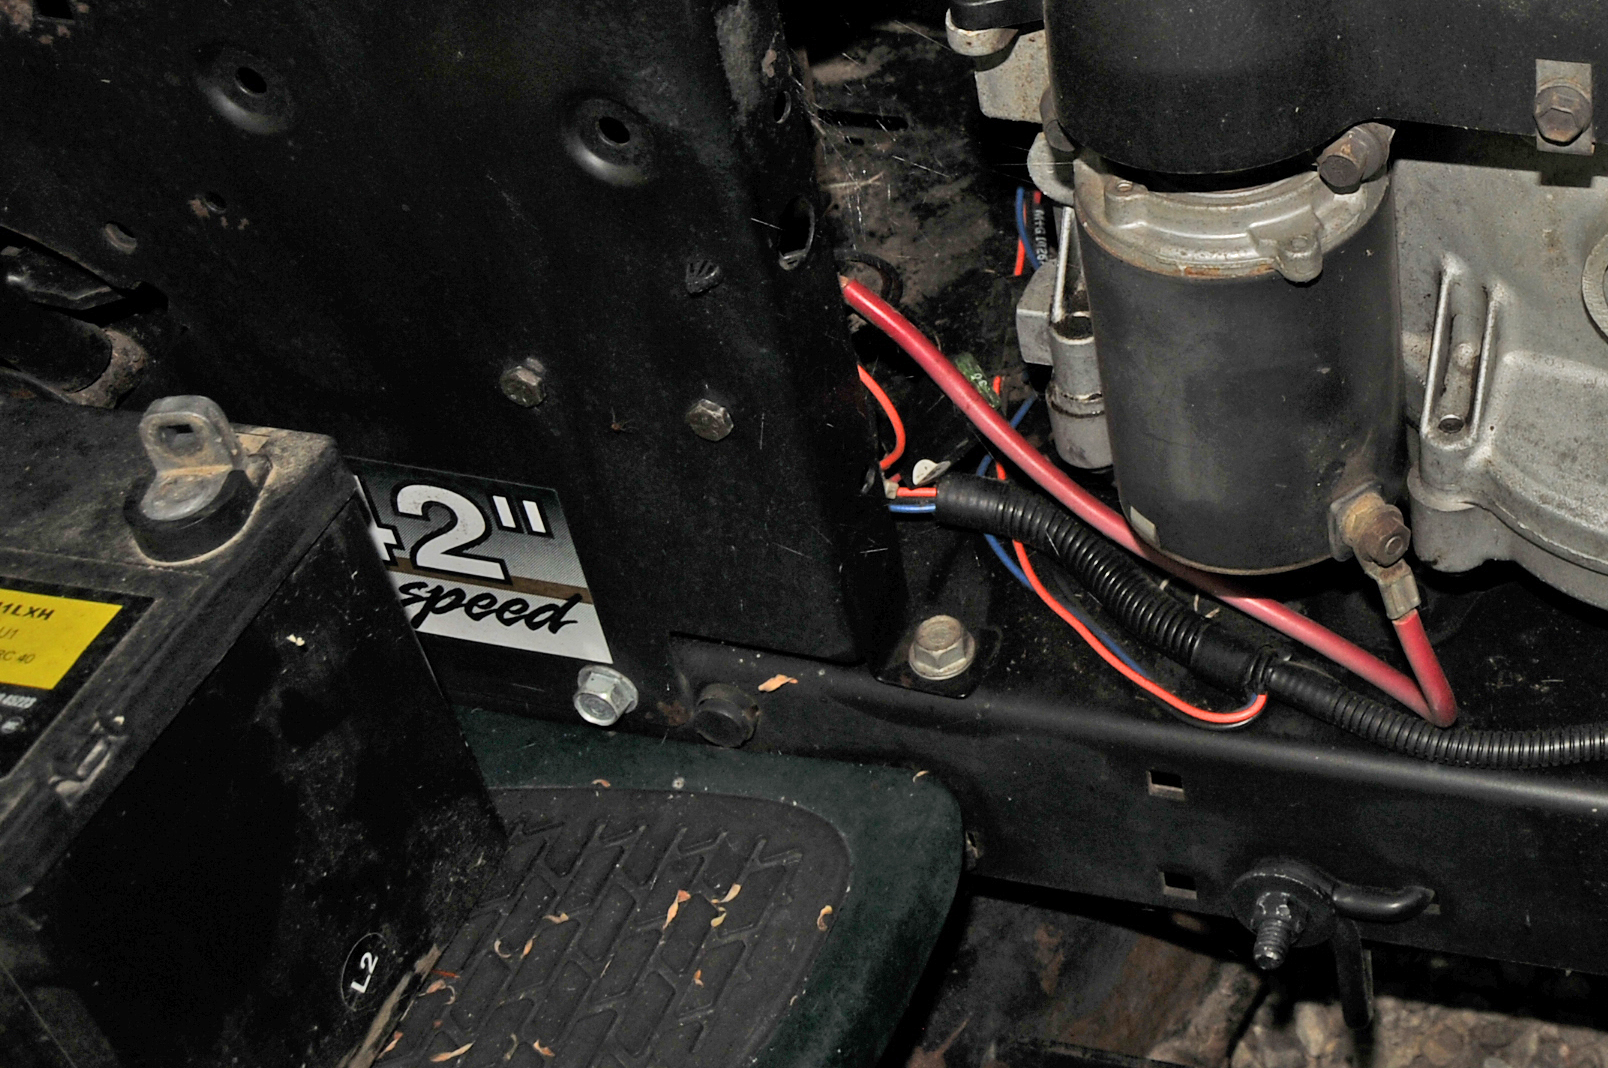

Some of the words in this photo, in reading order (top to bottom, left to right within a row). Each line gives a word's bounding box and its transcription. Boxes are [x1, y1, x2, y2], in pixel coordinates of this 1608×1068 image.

[0, 602, 55, 620] 1LXH
[399, 582, 583, 634] speed
[350, 952, 379, 993] L2
